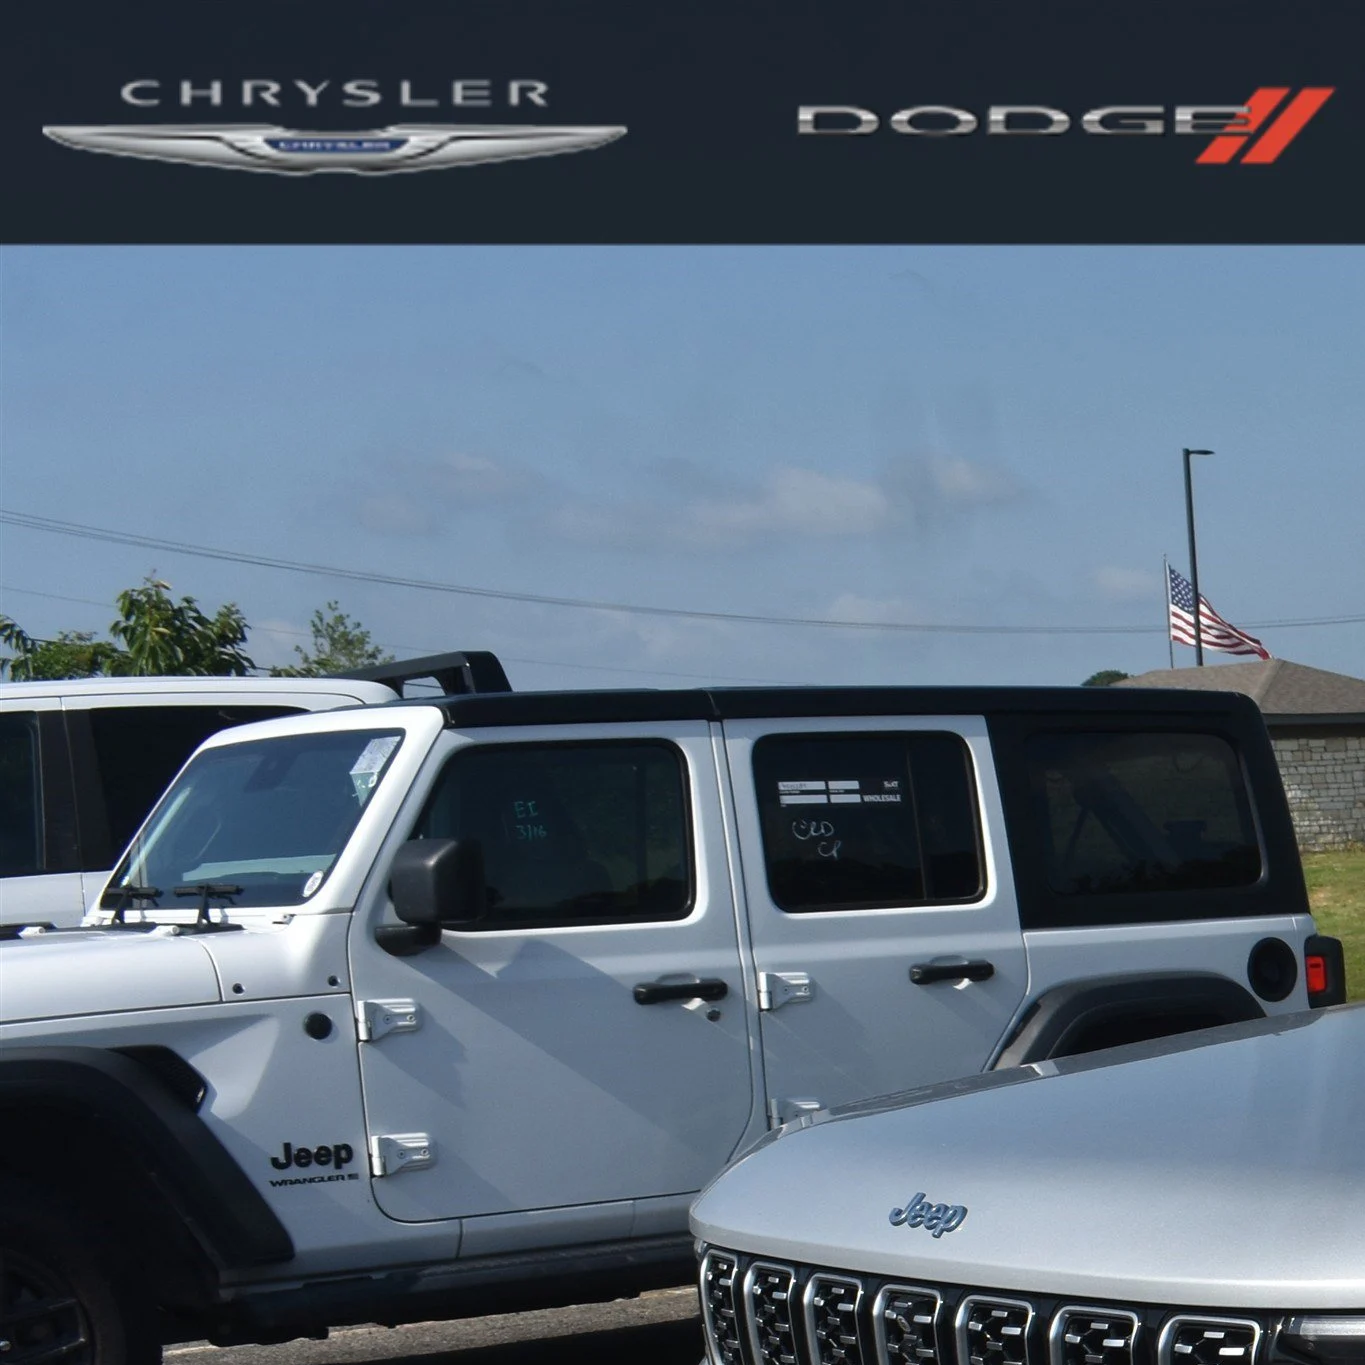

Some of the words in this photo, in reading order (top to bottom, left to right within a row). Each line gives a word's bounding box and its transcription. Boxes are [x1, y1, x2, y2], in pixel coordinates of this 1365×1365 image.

[270, 1142, 353, 1171] Jeep
[269, 1174, 346, 1188] WRANGLER
[889, 1192, 968, 1238] Jeep
